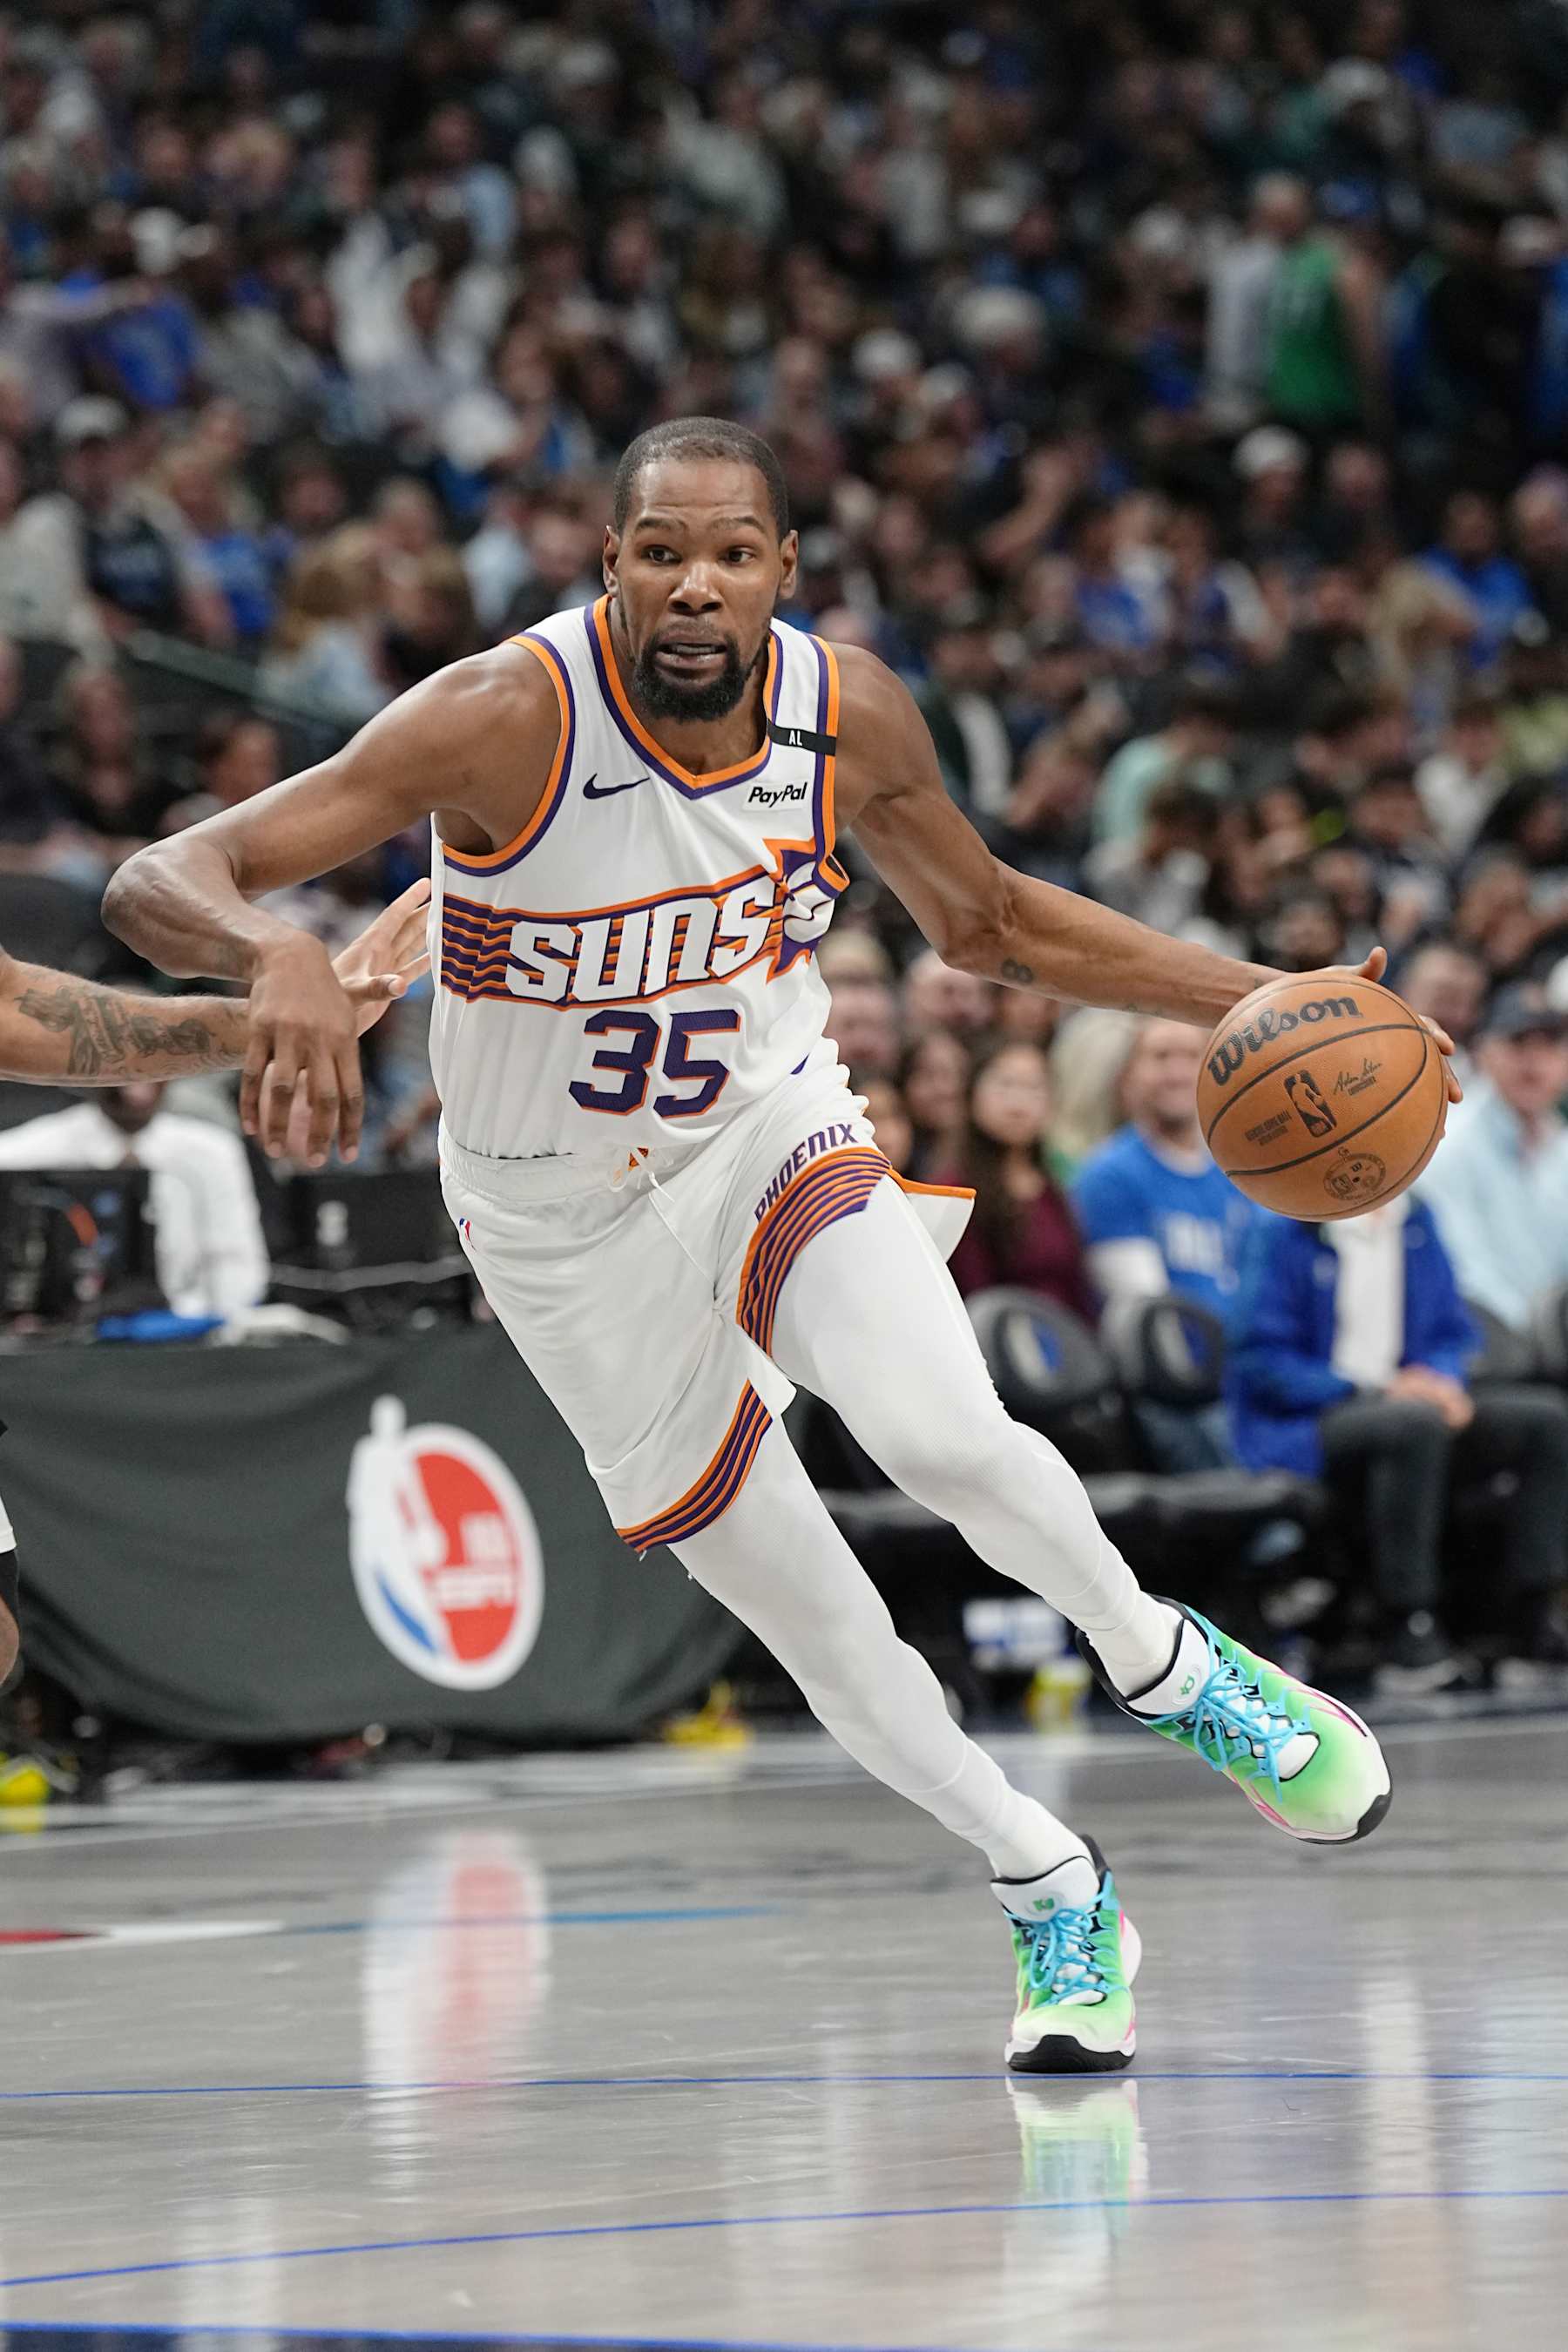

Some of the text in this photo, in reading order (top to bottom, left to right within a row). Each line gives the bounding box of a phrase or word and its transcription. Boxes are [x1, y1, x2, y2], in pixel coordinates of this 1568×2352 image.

[788, 729, 803, 746] AL
[747, 781, 808, 808] PayPal
[504, 875, 776, 1003] SUNS
[569, 1009, 741, 1119] 35
[1207, 996, 1363, 1086] Wilson
[754, 1123, 859, 1224] PHOENIX
